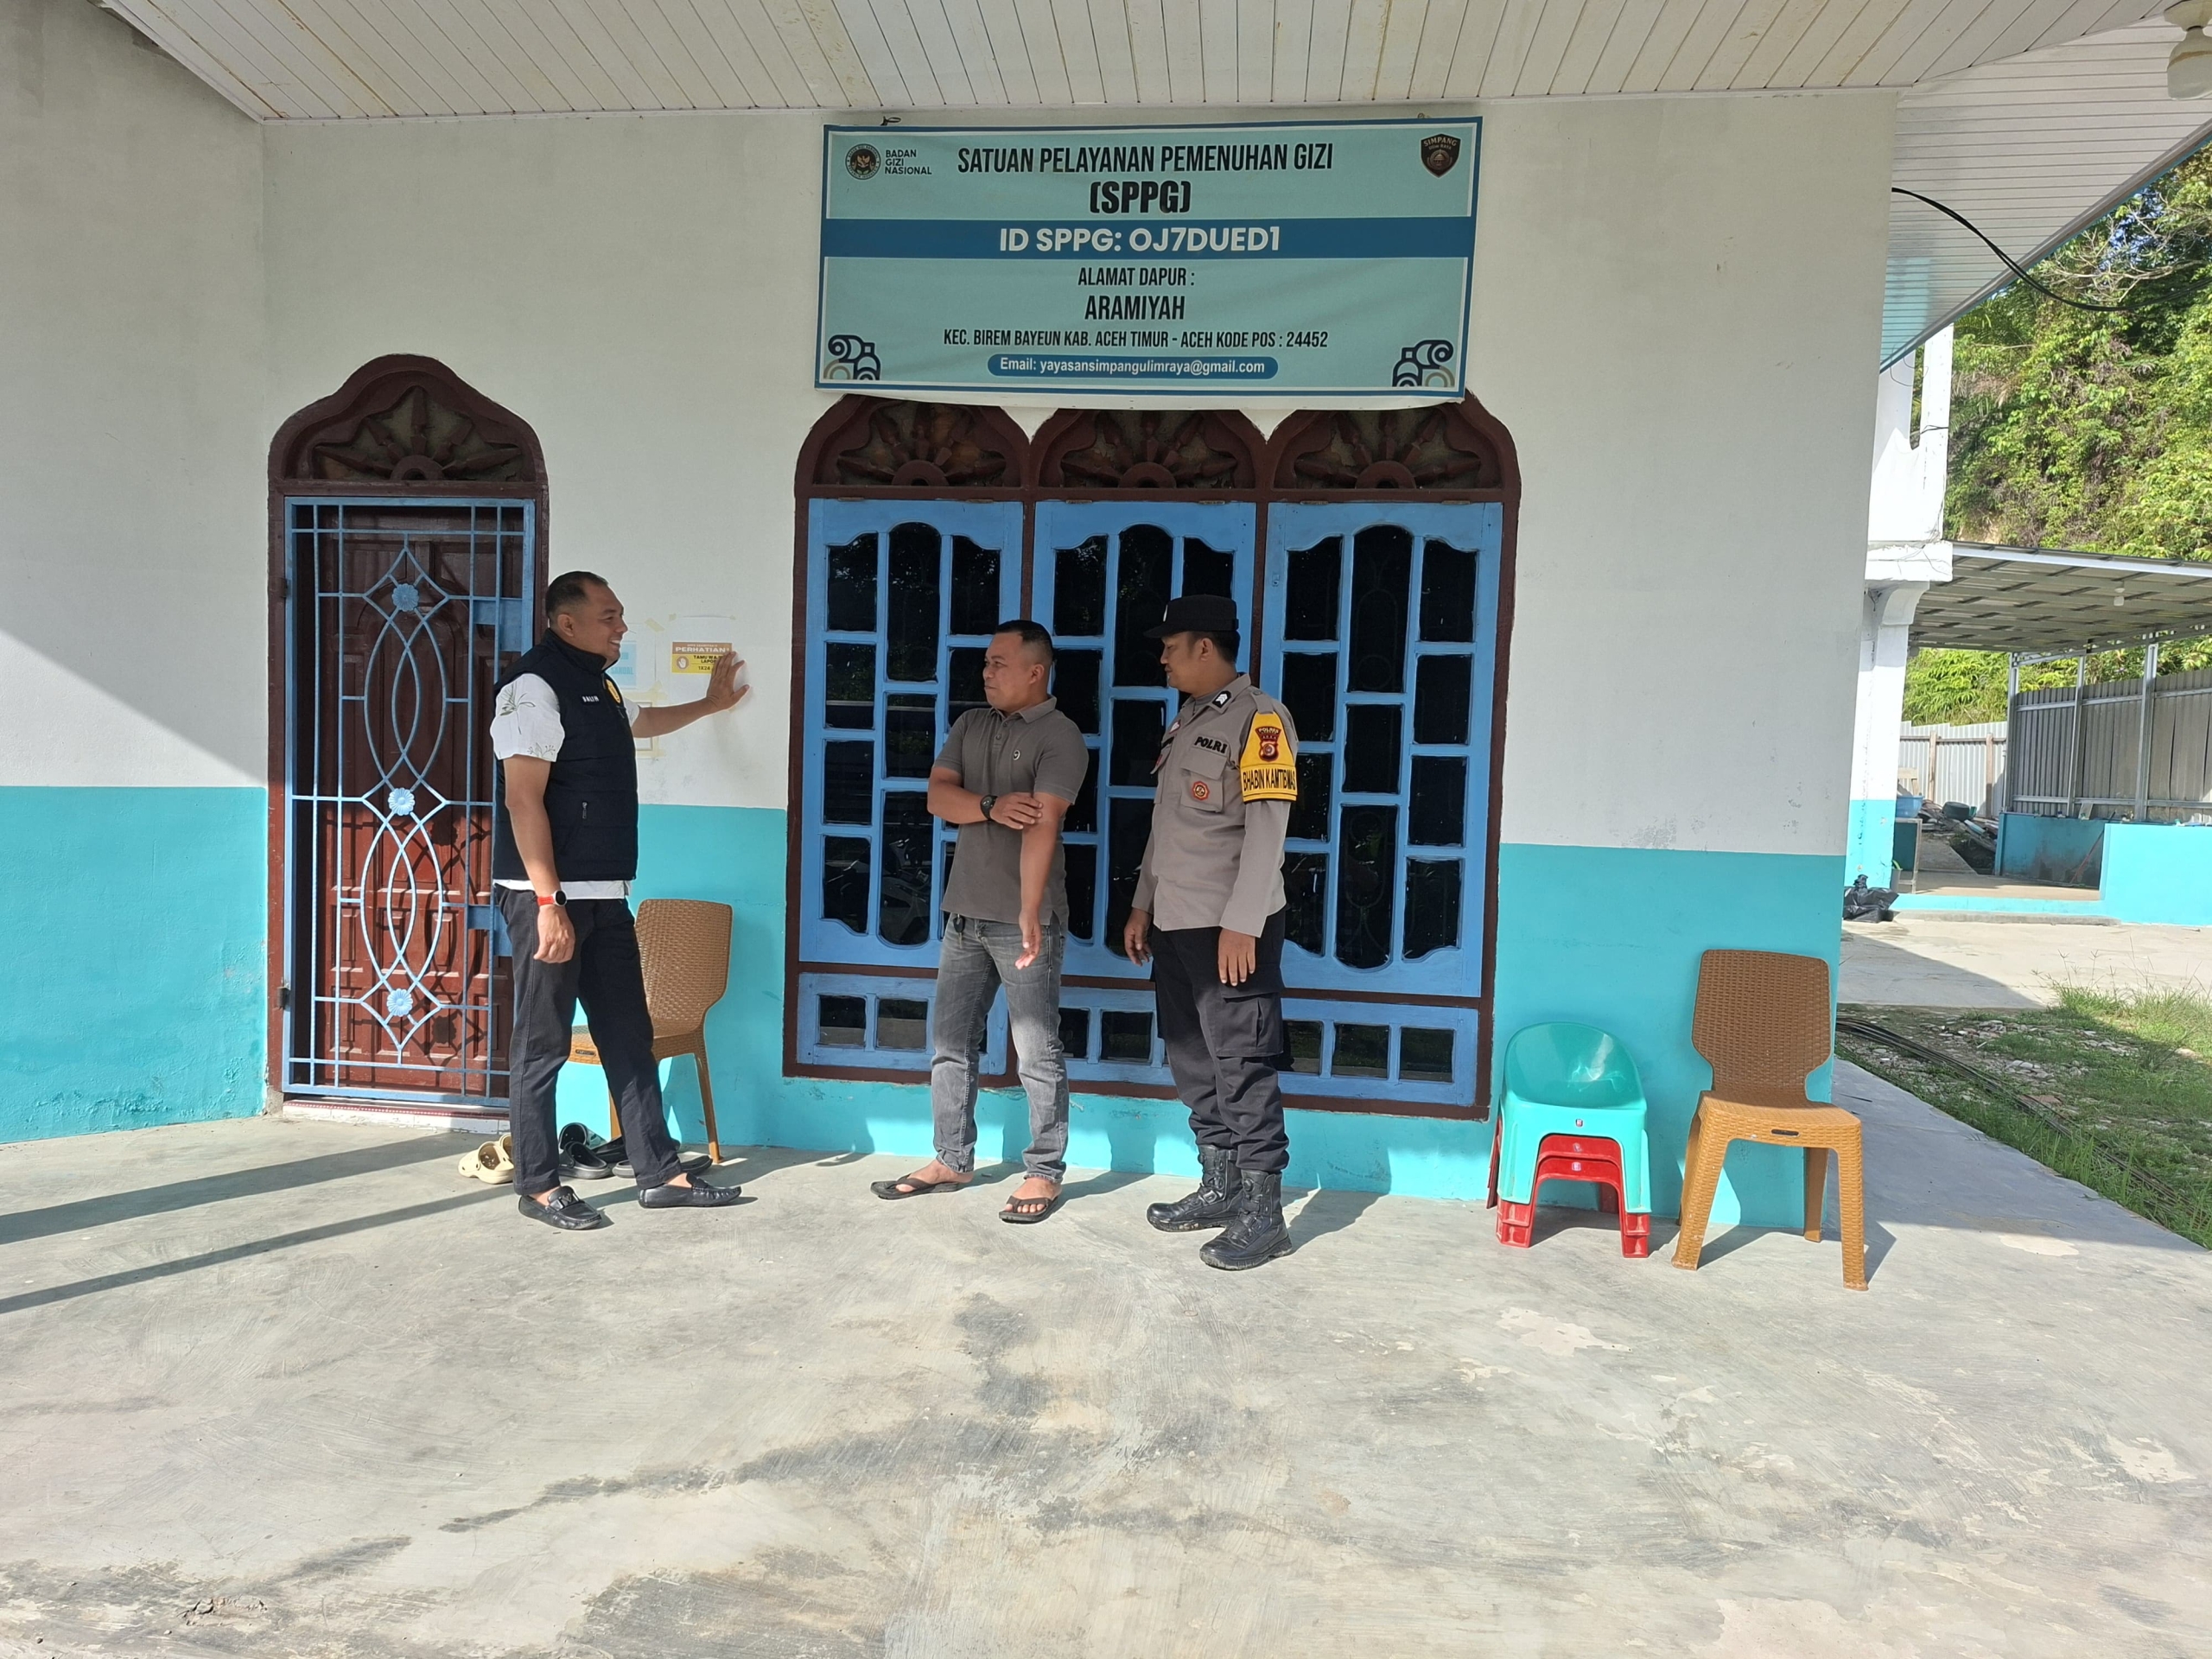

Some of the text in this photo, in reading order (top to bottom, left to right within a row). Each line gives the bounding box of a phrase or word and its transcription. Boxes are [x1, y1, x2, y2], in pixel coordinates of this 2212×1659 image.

[1423, 137, 1458, 147] SIMPANG
[957, 143, 1333, 173] SATUAN PELAYANAN PEMENUHAN GIZI
[1000, 227, 1029, 251] ID
[1036, 228, 1122, 251] SPPG:
[1077, 267, 1135, 286] ALAMAT
[1139, 267, 1187, 286] DAPUR
[1084, 295, 1185, 320] ARAMIYAH
[944, 329, 969, 345] KEC.
[973, 330, 1011, 346] BIREM
[1014, 330, 1060, 346] BAYEUN
[1064, 331, 1091, 346] KAB.
[1095, 331, 1127, 346] ACEH
[1130, 331, 1168, 346] TIMUR
[1180, 331, 1212, 347] ACEH
[1216, 332, 1249, 347] KODE
[1251, 331, 1275, 347] POS
[1287, 331, 1328, 347] 24452
[1000, 357, 1265, 376] Email: yayasansimpangulimraya@gmail.com
[1194, 736, 1228, 753] POLRI
[1243, 769, 1265, 791] BHABIN
